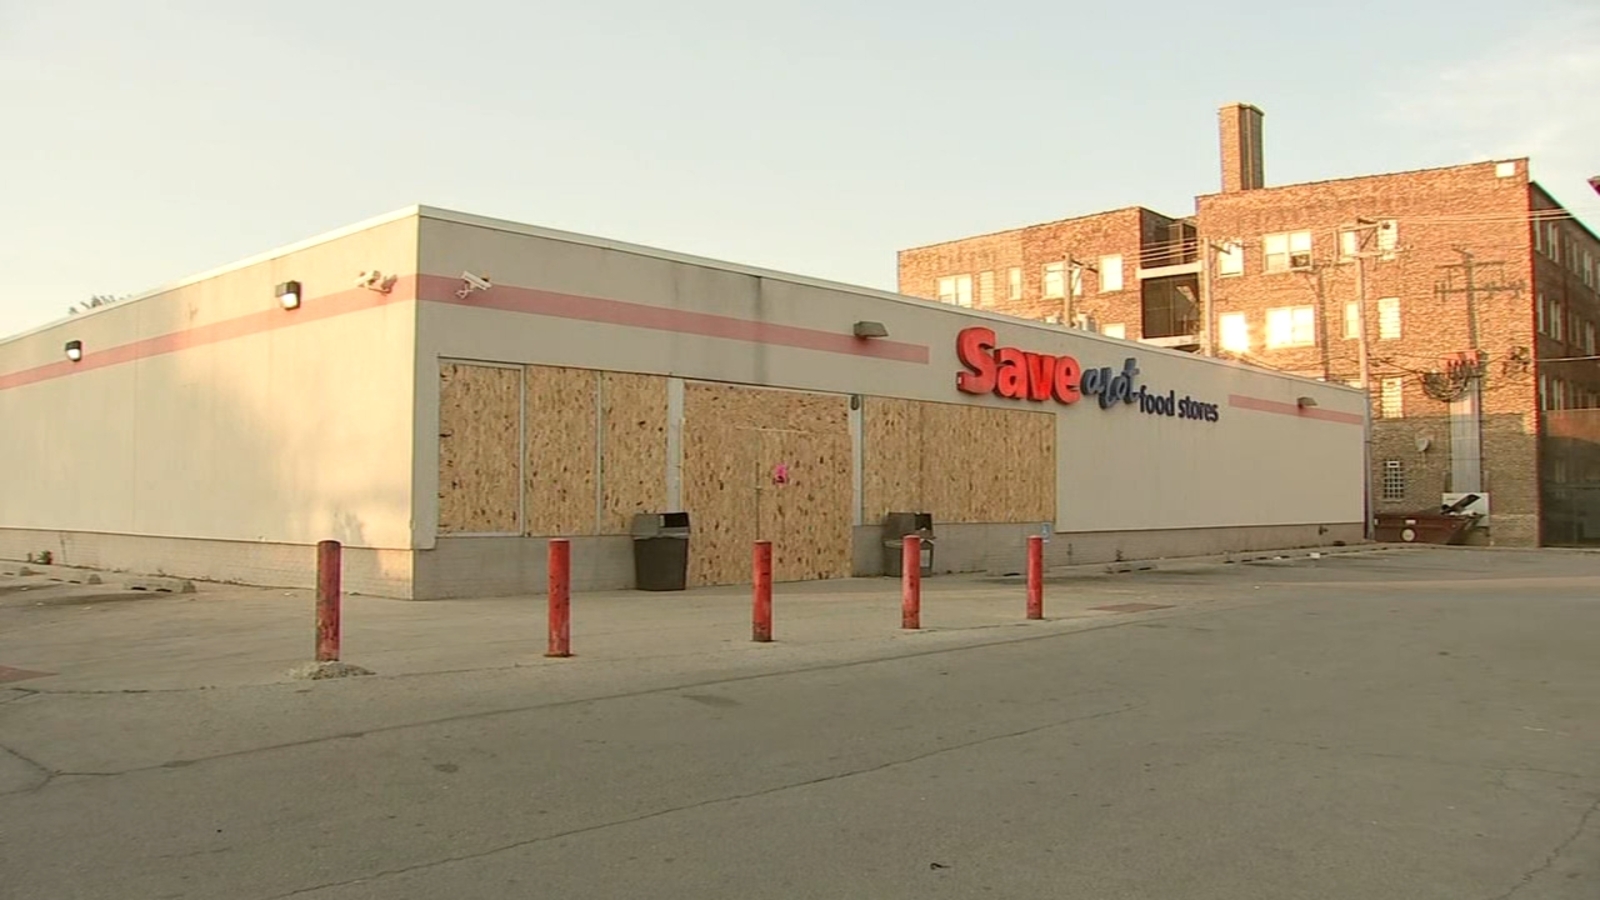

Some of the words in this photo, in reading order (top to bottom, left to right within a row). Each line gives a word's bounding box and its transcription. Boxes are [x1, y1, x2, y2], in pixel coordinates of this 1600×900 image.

[956, 326, 1081, 405] Save
[1138, 384, 1175, 416] food
[1178, 396, 1219, 422] stores
